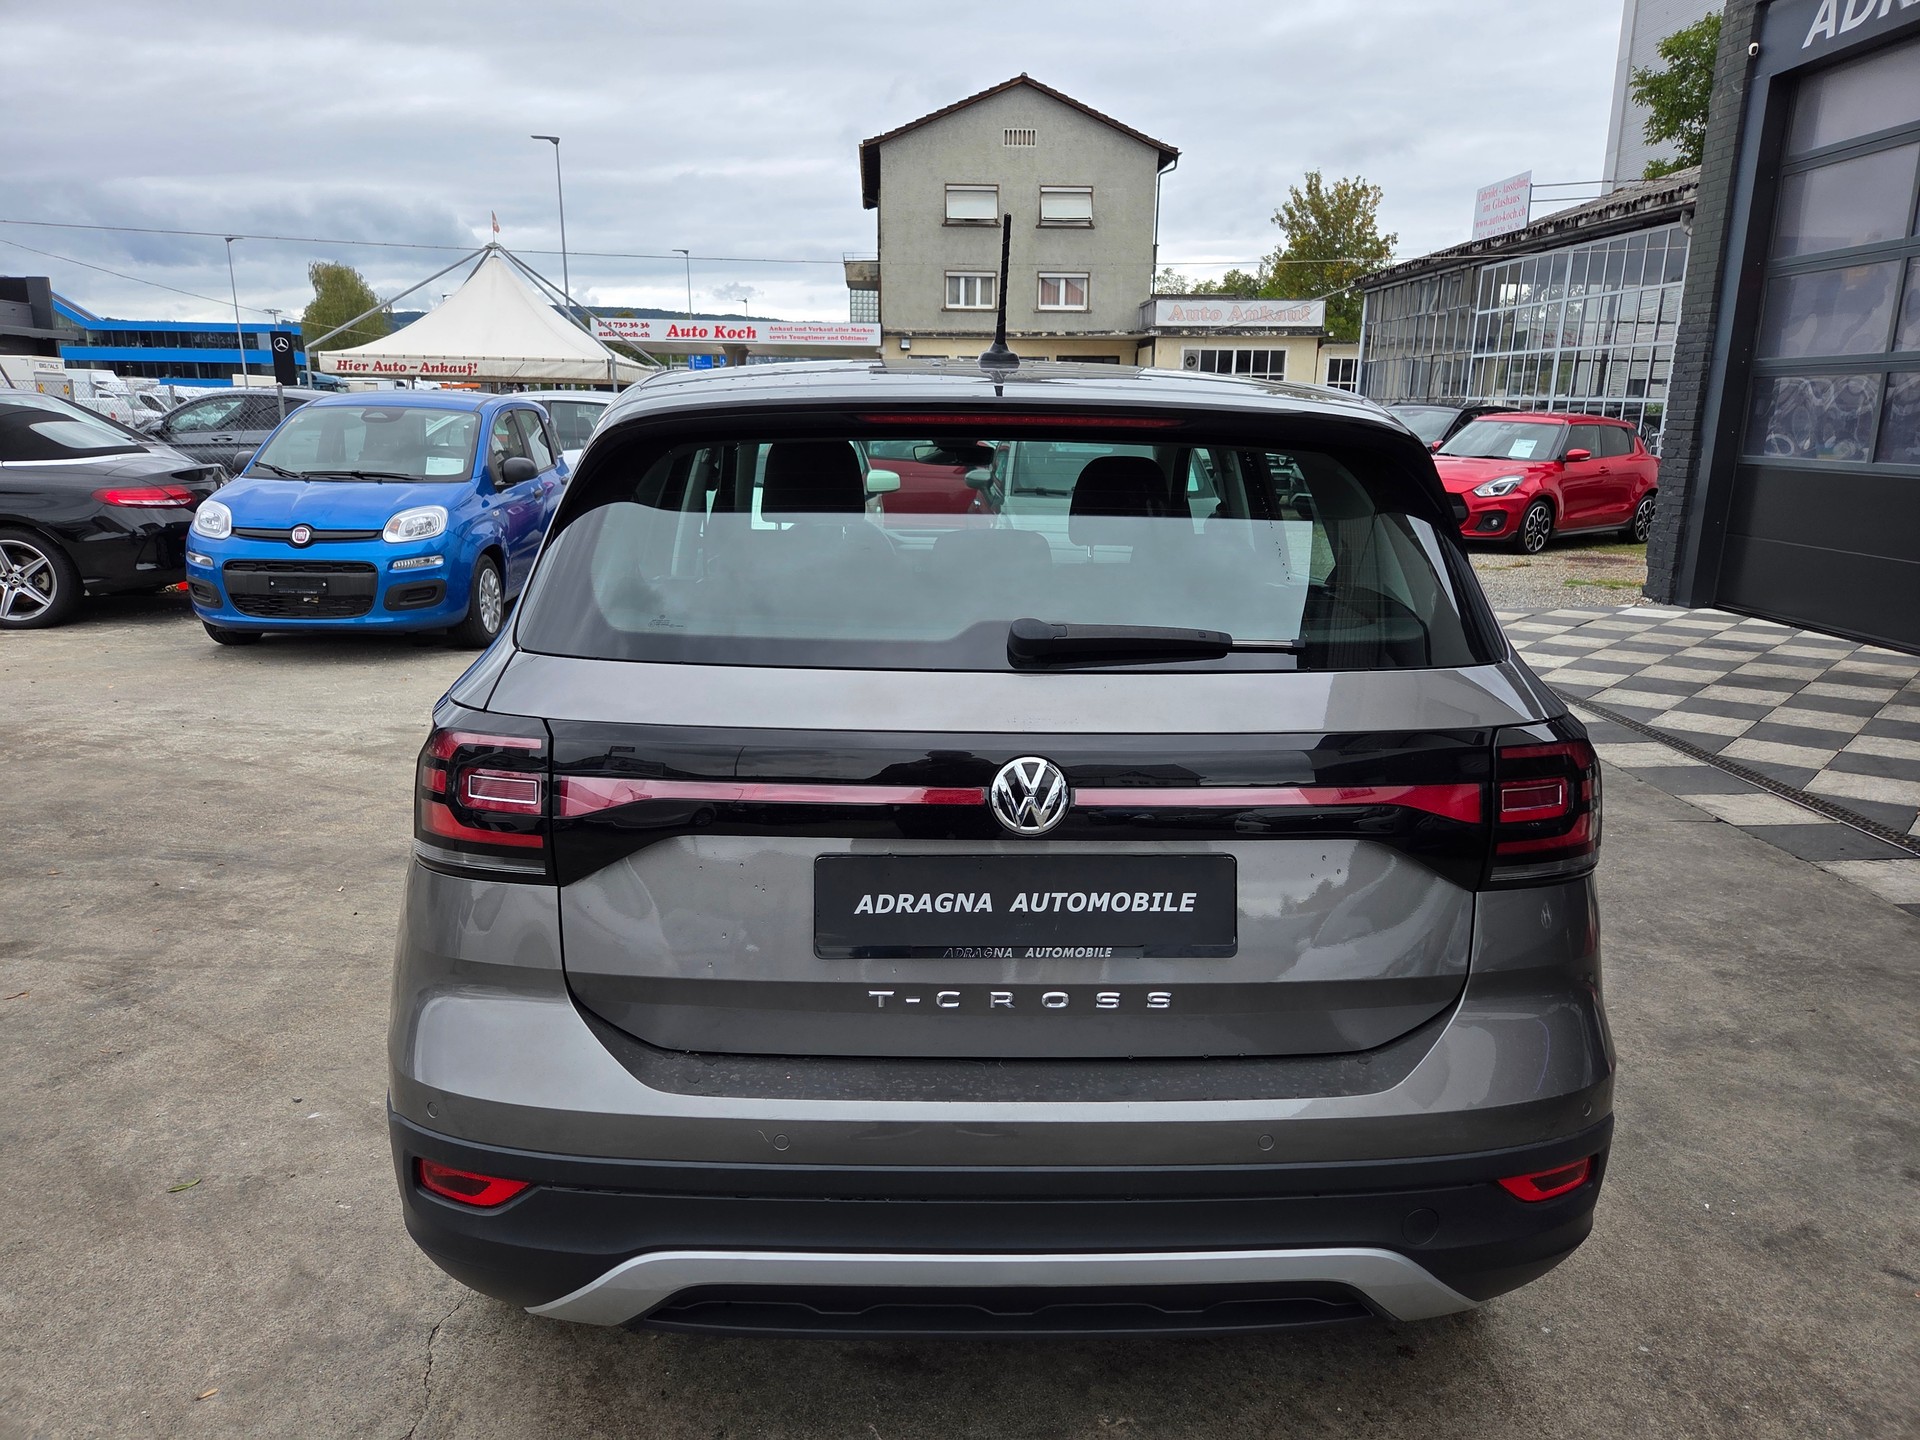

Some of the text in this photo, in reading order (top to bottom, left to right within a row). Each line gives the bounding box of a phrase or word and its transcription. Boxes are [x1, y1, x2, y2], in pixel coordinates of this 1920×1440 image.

[1802, 0, 1920, 49] AD
[1168, 304, 1312, 322] Auto Ankauf
[613, 321, 628, 329] 730
[666, 323, 757, 339] Auto Koch
[336, 360, 369, 371] Hier
[372, 361, 407, 373] Auto
[420, 362, 478, 376] Ankauf!
[854, 892, 1197, 914] ADRAGNA AUTOMOBILE
[943, 947, 1113, 959] ADRAGNA AUTOMOBILE
[868, 990, 1173, 1009] T-CROSS
